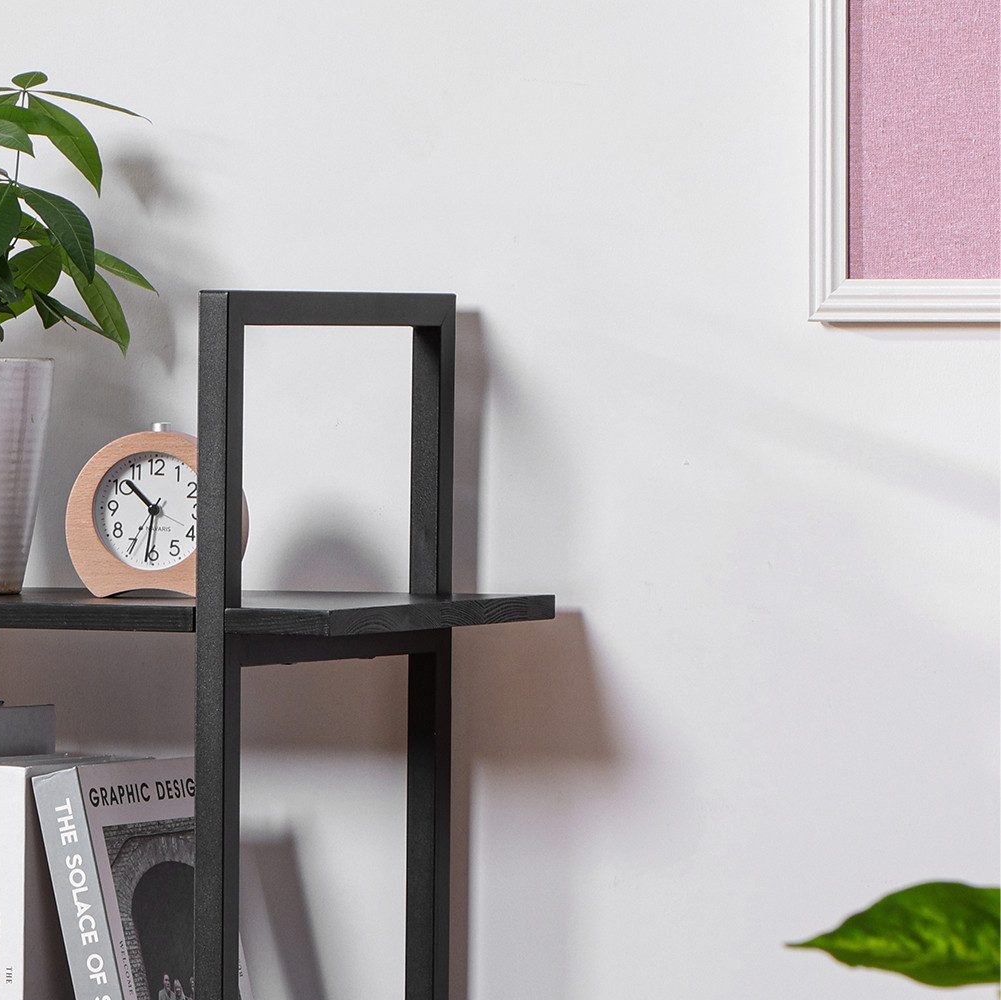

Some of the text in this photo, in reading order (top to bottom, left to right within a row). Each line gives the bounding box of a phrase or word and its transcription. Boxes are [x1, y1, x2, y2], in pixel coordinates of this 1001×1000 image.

[129, 464, 141, 480] 11
[147, 459, 166, 476] 12
[174, 465, 181, 482] 1
[112, 479, 134, 495] 10
[186, 482, 197, 498] 2
[107, 500, 119, 516] 9
[112, 522, 123, 538] 8
[185, 525, 196, 541] 4
[128, 538, 137, 555] 7
[148, 545, 159, 561] 6
[169, 540, 181, 556] 5
[88, 777, 196, 808] GRAPHIC DESIG
[54, 797, 79, 846] THE
[65, 854, 99, 946] SOLACE
[5, 966, 13, 984] THE
[86, 952, 108, 986] OF
